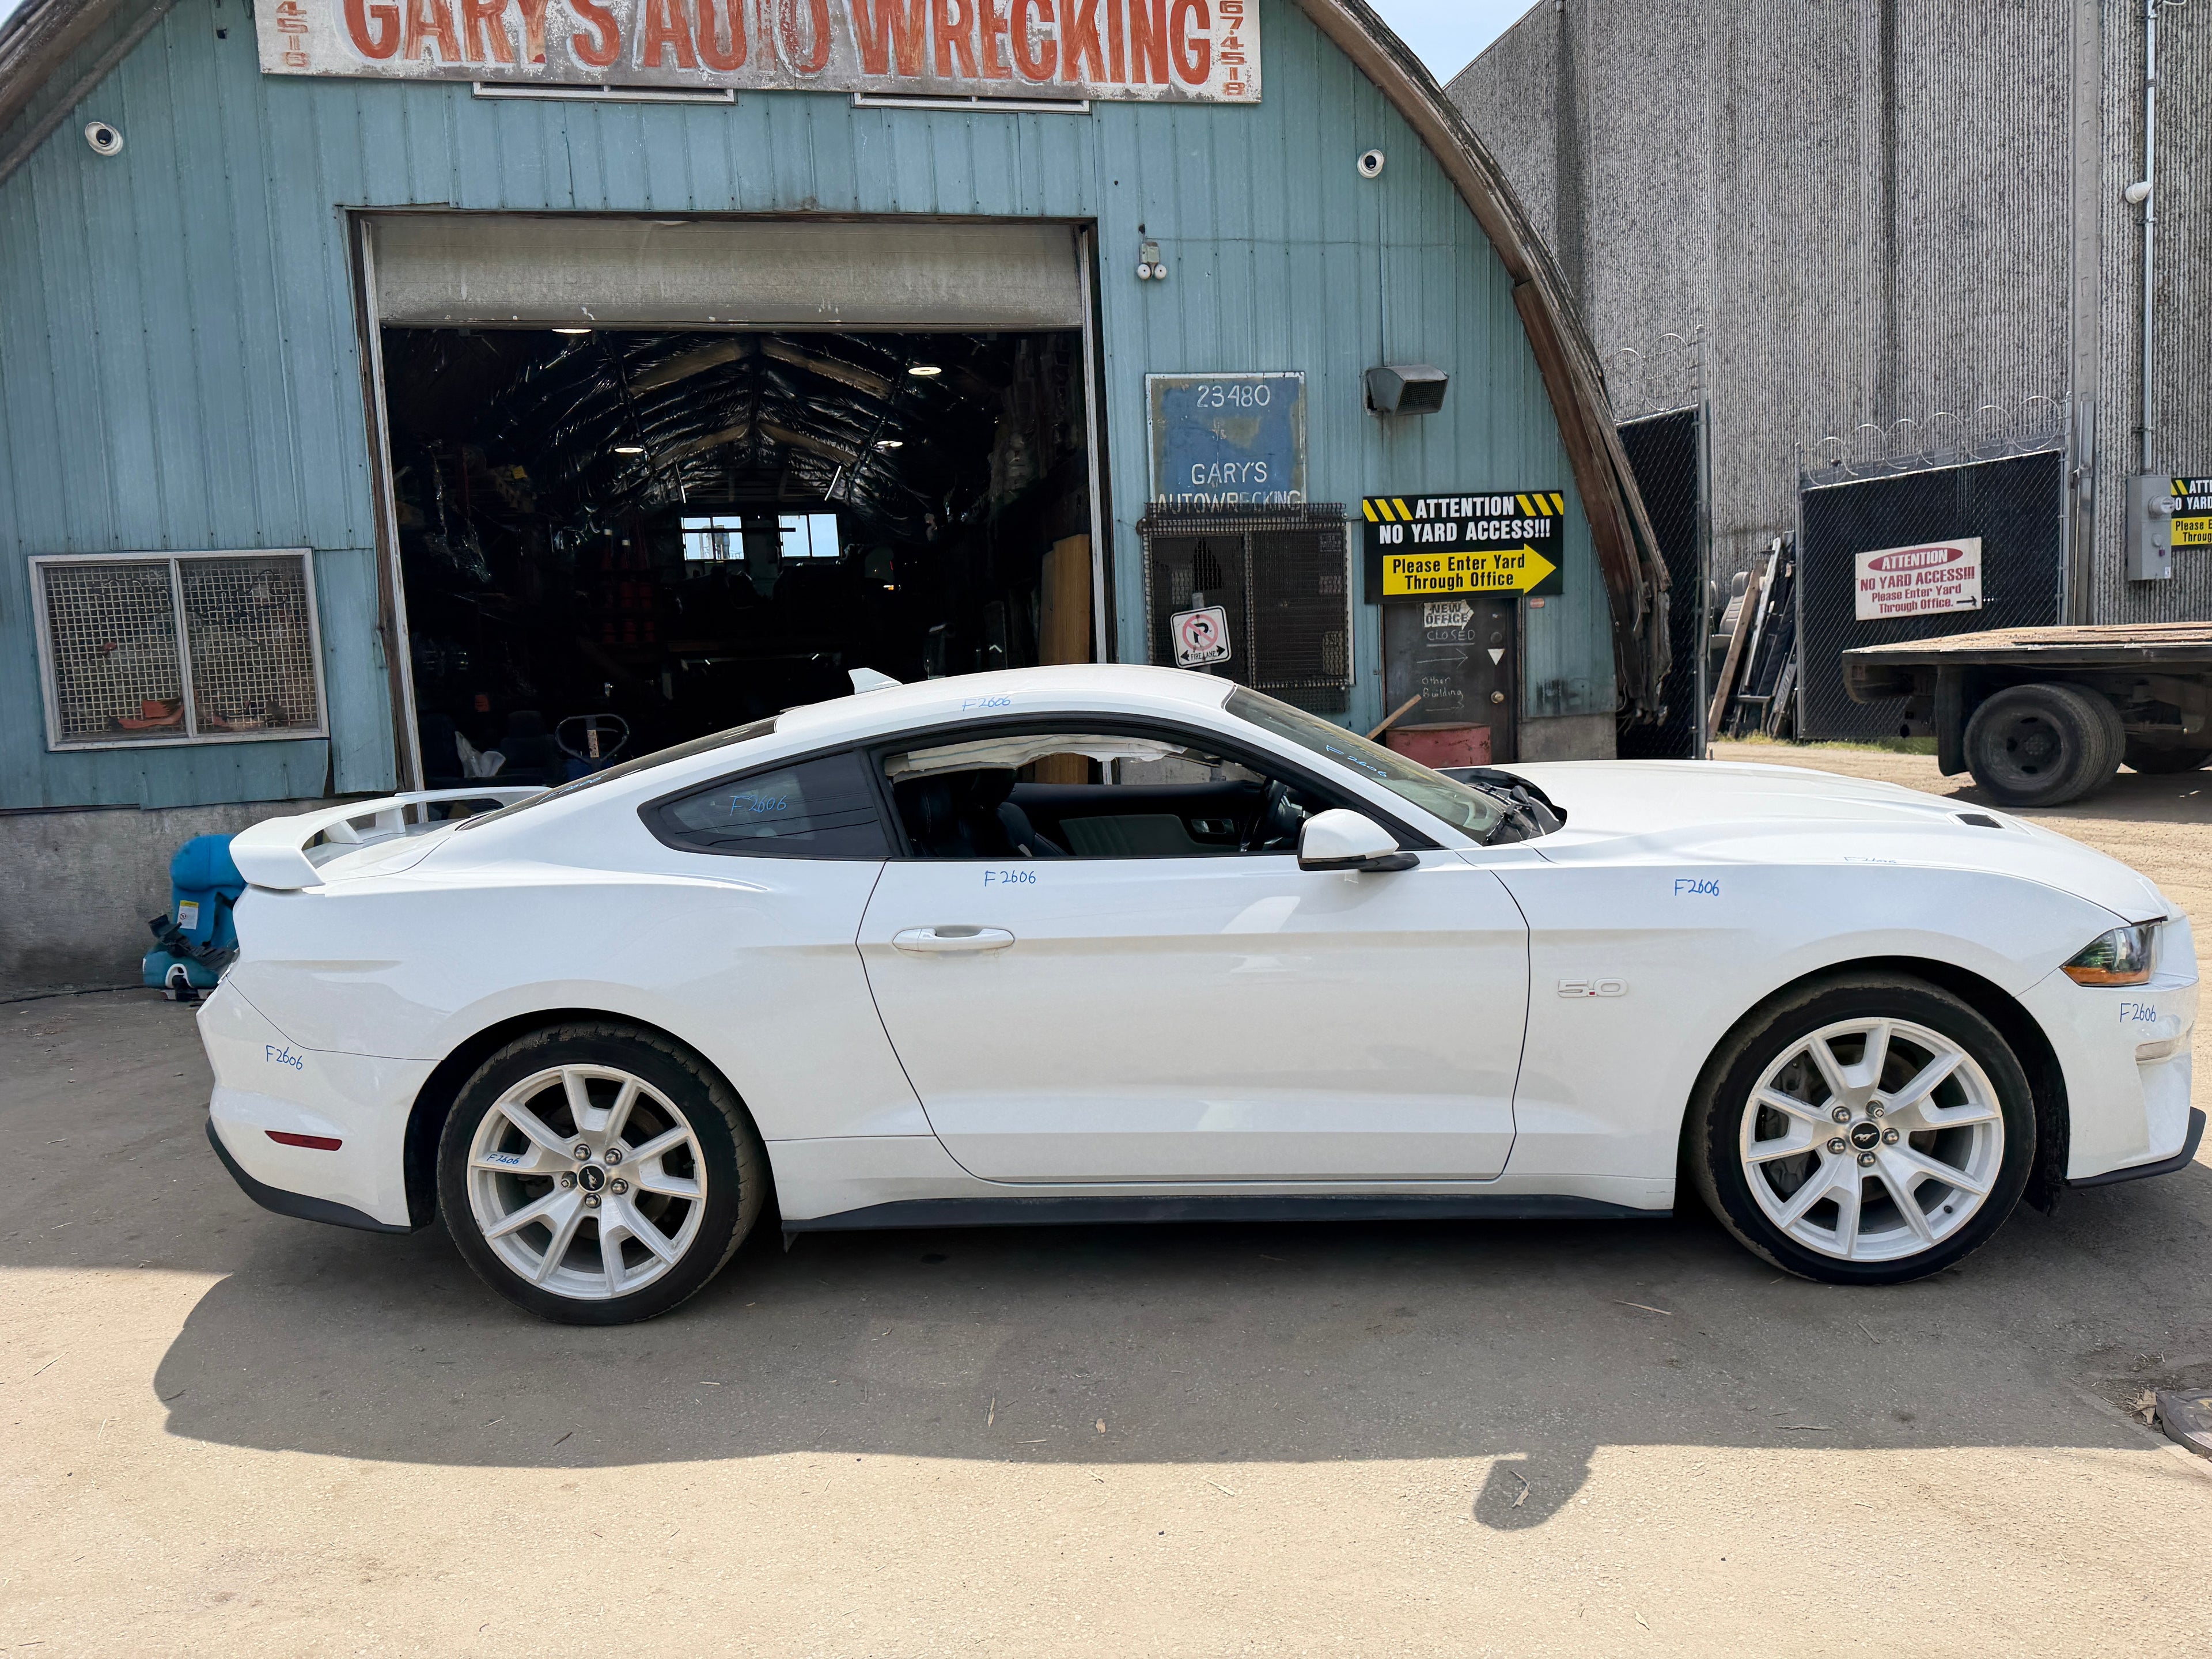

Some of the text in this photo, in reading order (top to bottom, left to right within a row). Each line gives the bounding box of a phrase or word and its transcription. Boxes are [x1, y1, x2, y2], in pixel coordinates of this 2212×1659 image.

[853, 0, 1211, 85] WRECKING
[1196, 384, 1270, 408] 23480
[1191, 461, 1267, 485] GARY'S
[1415, 496, 1514, 518] ATTENTION
[1379, 518, 1551, 544] NO YARD ACCESS!!!
[2175, 520, 2204, 531] Please
[1393, 554, 1525, 574] Please Enter Yard
[1881, 549, 1948, 570] ATTENTION
[1404, 571, 1513, 591] Through Office
[1861, 566, 1975, 592] NO YARD ACCESS!!!
[1872, 584, 1961, 603] Please Enter Yard
[1432, 603, 1460, 613] NEW
[1879, 601, 1918, 613] Through
[1426, 613, 1468, 625] OFFICE
[1427, 630, 1475, 641] CLOSED
[1422, 676, 1450, 685] Other
[961, 696, 1010, 711] F2606
[729, 795, 787, 816] F2606
[984, 870, 1036, 887] F2606
[1675, 879, 1719, 896] F2606
[1557, 978, 1628, 998] 5.0
[2119, 1002, 2156, 1022] F2606
[266, 1044, 303, 1070] F2606
[486, 1154, 521, 1164] F2606
